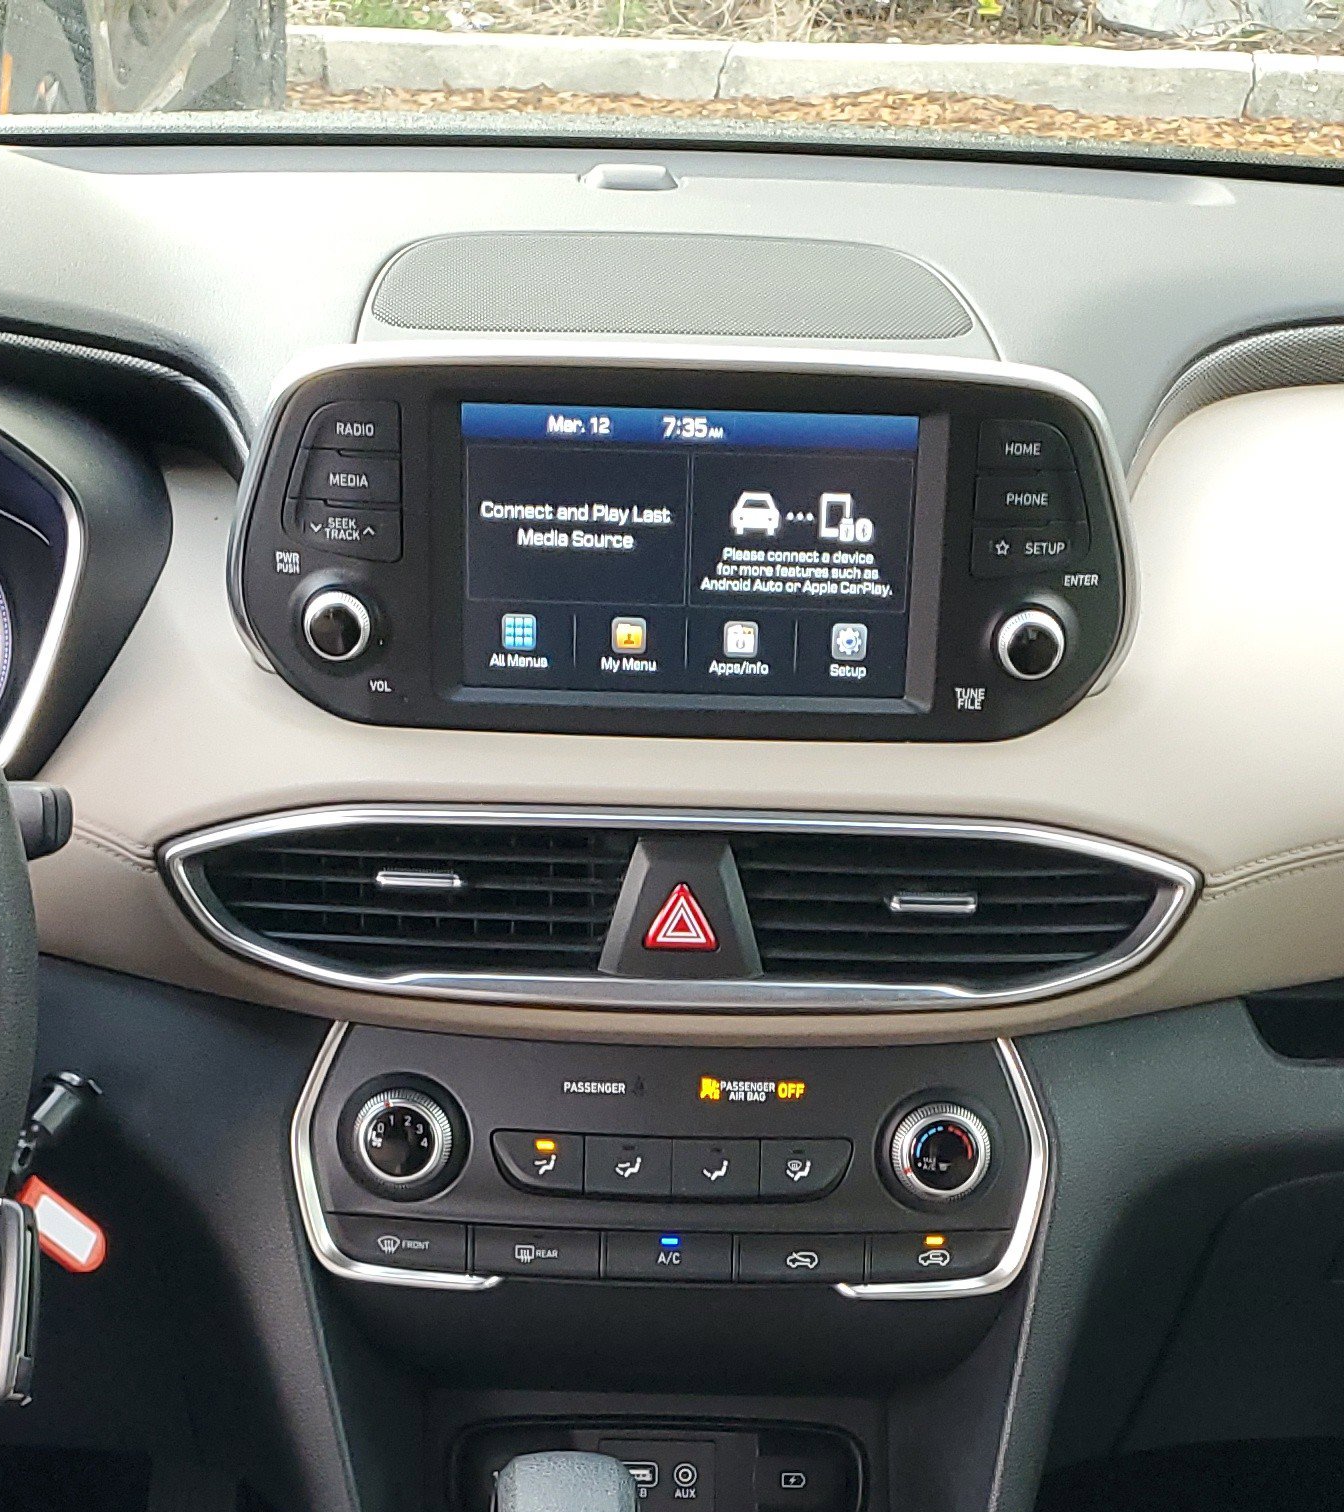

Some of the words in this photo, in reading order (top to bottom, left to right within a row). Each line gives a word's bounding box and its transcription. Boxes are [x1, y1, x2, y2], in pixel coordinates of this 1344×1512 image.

[336, 421, 374, 437] RADIO
[546, 414, 586, 434] Mar.
[589, 416, 611, 434] 12
[1004, 441, 1041, 456] HOME
[329, 472, 369, 488] MEDIA
[1005, 492, 1049, 506] PHONE
[480, 500, 554, 520] Connect
[556, 503, 589, 521] and
[592, 504, 630, 526] Play
[632, 505, 672, 524] Last
[328, 516, 357, 529] SEEK
[324, 528, 361, 541] TRACK
[517, 527, 569, 547] Media
[572, 529, 635, 549] Source
[1025, 541, 1066, 555] SETUP
[275, 550, 300, 563] PWR
[722, 547, 765, 562] Please
[767, 550, 820, 564] connect
[821, 554, 830, 564] a
[833, 550, 874, 564] device
[276, 562, 300, 574] PUSH
[716, 562, 738, 576] for
[739, 566, 774, 577] more
[775, 564, 829, 579] features
[831, 567, 861, 580] such
[863, 570, 879, 580] as
[1063, 573, 1099, 587] ENTER
[700, 577, 751, 592] Android
[752, 579, 783, 593] Auto
[785, 582, 802, 593] or
[802, 580, 838, 596] Apple
[840, 581, 893, 599] CarPlay.
[489, 653, 506, 668] All
[507, 653, 549, 669] Menus
[600, 656, 620, 673] My
[622, 657, 657, 672] Menu
[708, 659, 769, 676] Apps/Info
[829, 663, 867, 679] Setup
[369, 679, 392, 693] VOL
[954, 687, 986, 700] TUNE
[957, 698, 982, 710] FILE
[563, 1081, 626, 1095] PASSENGER
[720, 1080, 776, 1093] PASSENGER
[777, 1082, 806, 1099] OFF
[728, 1091, 746, 1102] AIR
[746, 1091, 766, 1102] BAG
[377, 1122, 385, 1133] 0
[404, 1115, 412, 1127] 2
[416, 1123, 424, 1135] 3
[420, 1137, 429, 1148] 4
[401, 1239, 430, 1251] FRONT
[535, 1248, 558, 1259] REAR
[657, 1251, 682, 1266] A/C
[674, 1488, 696, 1499] AUX
